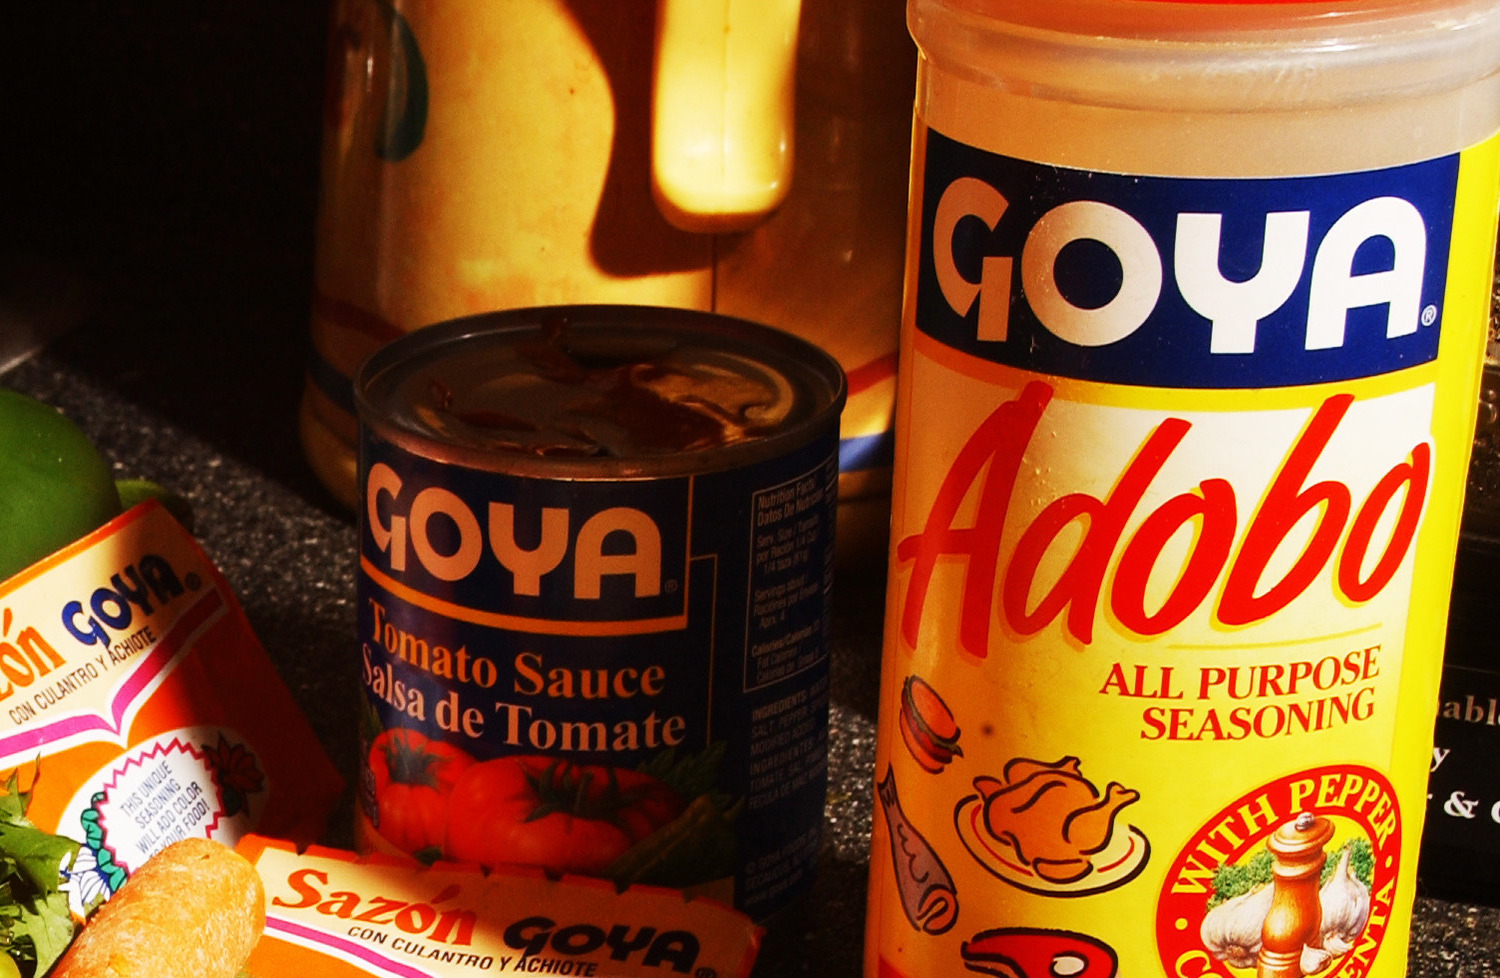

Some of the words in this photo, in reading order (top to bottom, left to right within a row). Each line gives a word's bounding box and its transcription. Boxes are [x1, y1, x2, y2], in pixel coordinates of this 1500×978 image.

[933, 176, 1427, 354] GOYA
[366, 462, 662, 599] GOYA
[896, 380, 1431, 660] Adobo
[61, 554, 185, 649] GOYA
[367, 598, 498, 689] Tomato
[514, 651, 666, 700] Sauce
[9, 701, 36, 725] CON
[33, 662, 99, 710] CULANTRO
[96, 655, 108, 672] Y
[108, 625, 157, 665] ACHIOTE
[362, 642, 426, 722] Salsa
[434, 694, 486, 740] de
[495, 701, 687, 752] Tomate
[1100, 662, 1184, 700] ALL
[1198, 645, 1381, 700] PURPOSE
[1140, 688, 1375, 741] SEASONING
[1437, 694, 1500, 727] abl
[120, 792, 143, 817] THIS
[138, 760, 172, 798] UNIQUE
[135, 778, 181, 829] SEASONING
[136, 829, 160, 854] WILL
[157, 809, 176, 832] ADD
[172, 781, 202, 815] COLOR
[182, 798, 210, 832] FOOD!
[1171, 794, 1279, 894] WITH
[1289, 774, 1396, 850] PEPPER
[271, 868, 477, 947] Sazón
[502, 915, 700, 976] GOYA
[348, 925, 388, 944] CON
[390, 937, 493, 971] CULANTRO
[499, 955, 512, 972] Y
[513, 953, 598, 978] ACHIOTE
